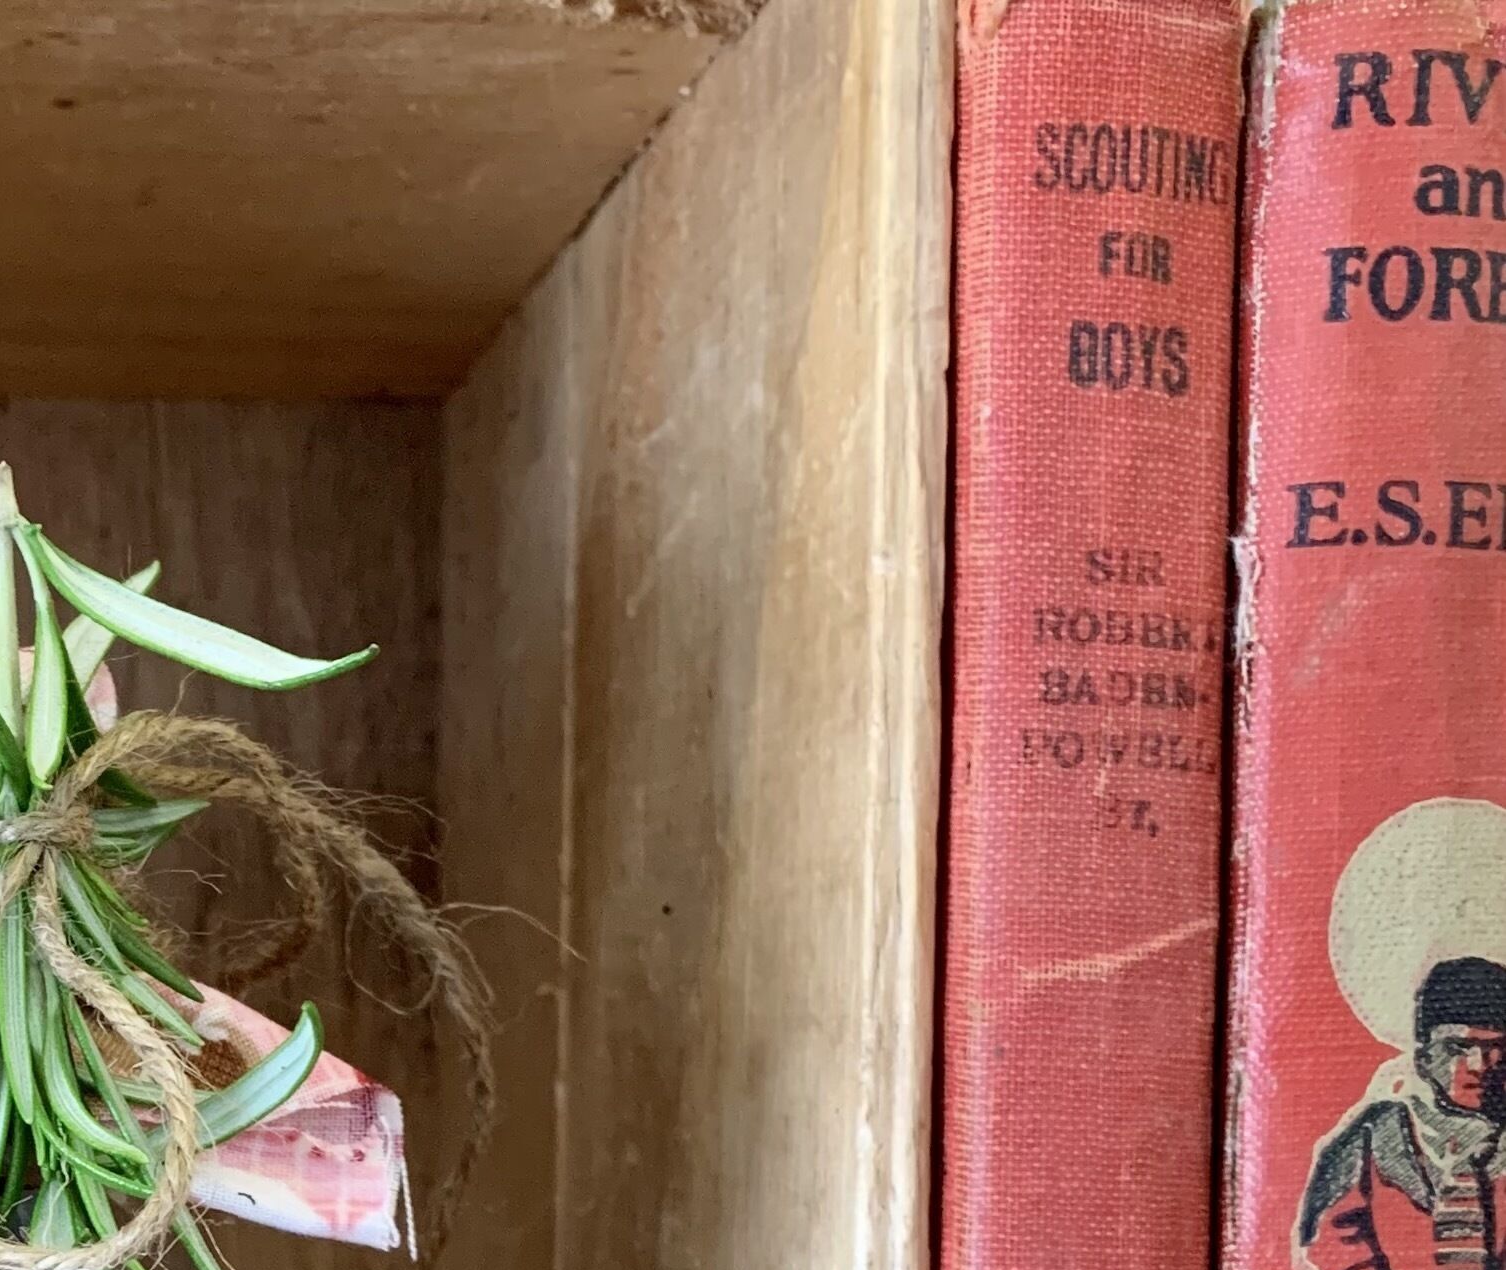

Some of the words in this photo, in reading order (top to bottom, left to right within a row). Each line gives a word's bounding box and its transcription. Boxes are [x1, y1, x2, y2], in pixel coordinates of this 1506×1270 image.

[1034, 121, 1230, 206] SCOUTING
[1098, 230, 1173, 286] FOR
[1068, 320, 1191, 398] BOYS
[1285, 480, 1506, 551] E.S.E
[1086, 548, 1167, 588] SIR
